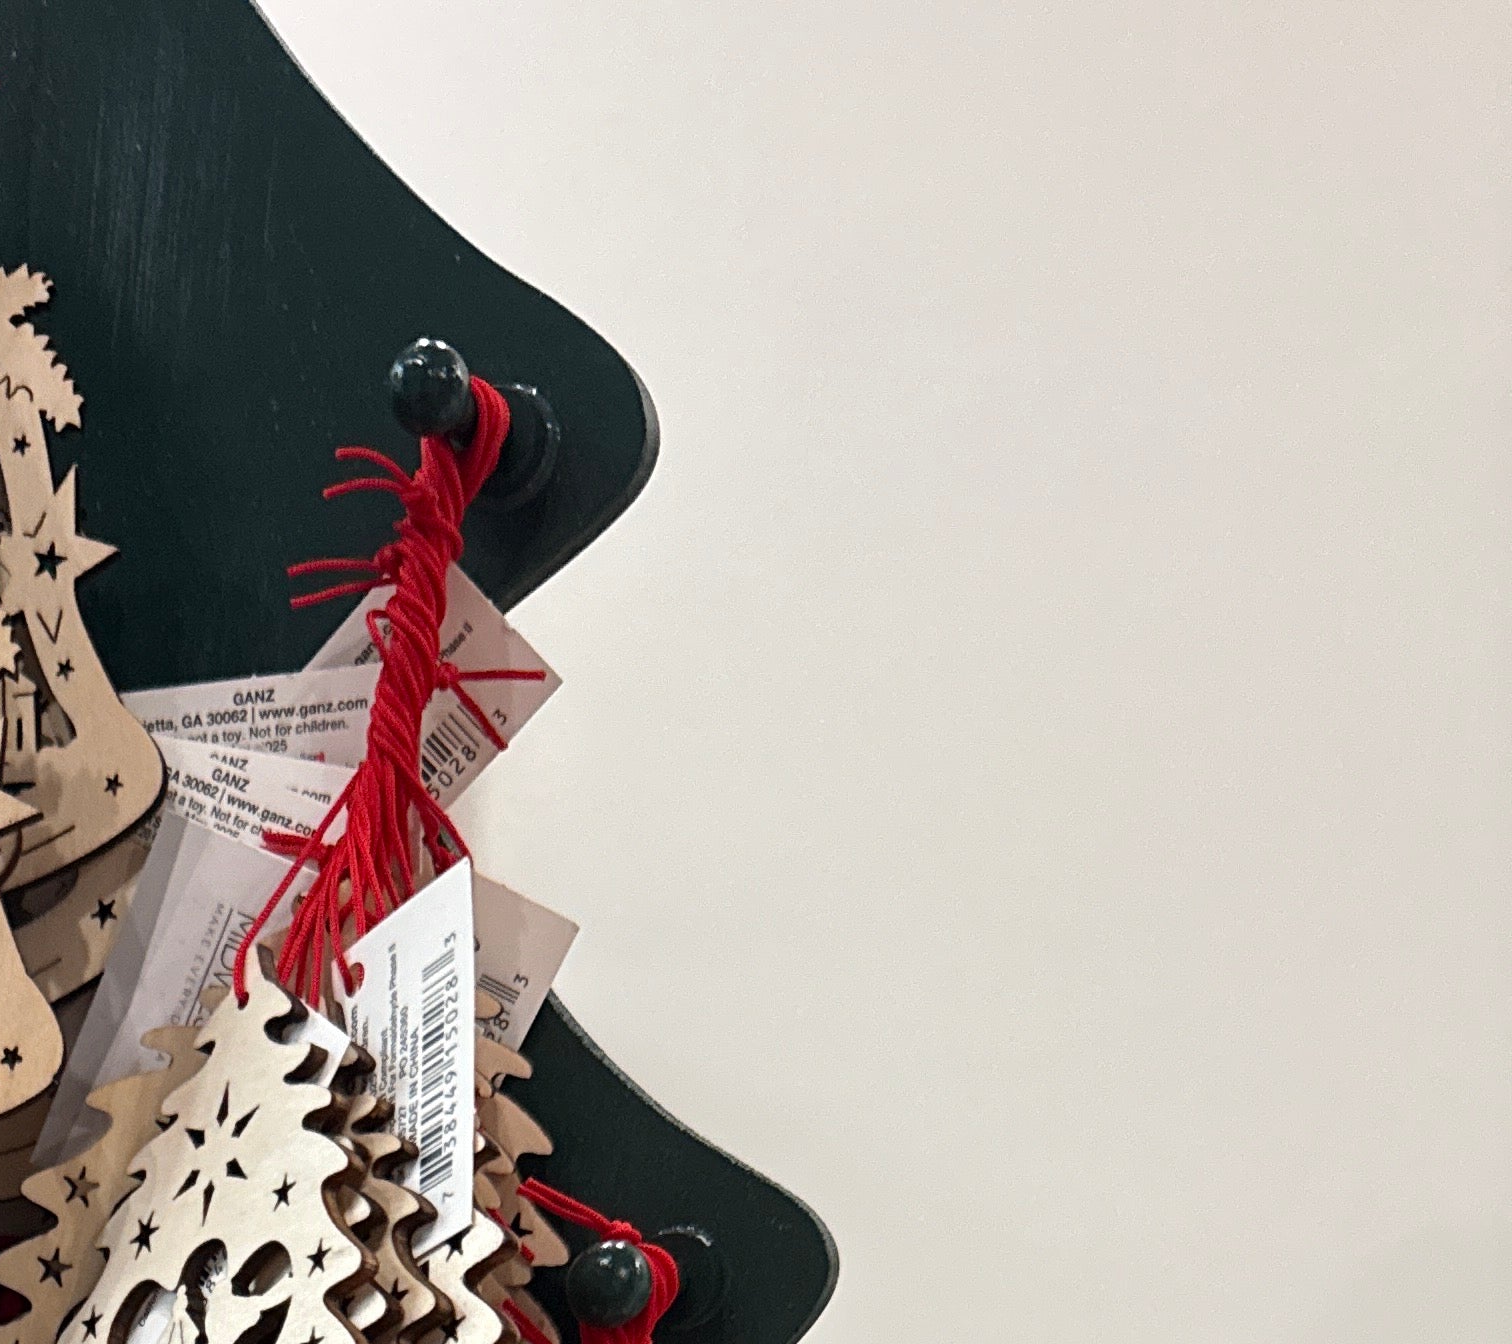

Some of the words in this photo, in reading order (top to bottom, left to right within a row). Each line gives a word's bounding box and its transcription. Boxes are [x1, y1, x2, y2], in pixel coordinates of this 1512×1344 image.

[233, 689, 275, 706] GANZ
[142, 717, 178, 733] ietta,
[182, 713, 203, 729] GA
[207, 709, 248, 727] 30062
[259, 697, 368, 720] www.ganz.com
[222, 729, 244, 746] toy.
[249, 727, 271, 740] Not
[275, 724, 292, 736] for
[296, 720, 349, 735] children.
[426, 744, 477, 800] 5028
[492, 709, 508, 726] 3
[184, 775, 219, 800] 30062
[212, 768, 250, 793] GANZ
[211, 806, 232, 823] Not
[233, 815, 248, 833] for
[444, 932, 456, 949] 3
[514, 974, 528, 988] 3
[444, 975, 459, 1063] 15028
[406, 1027, 423, 1080] CHINA
[408, 1081, 419, 1099] IN
[443, 1071, 458, 1156] 38449
